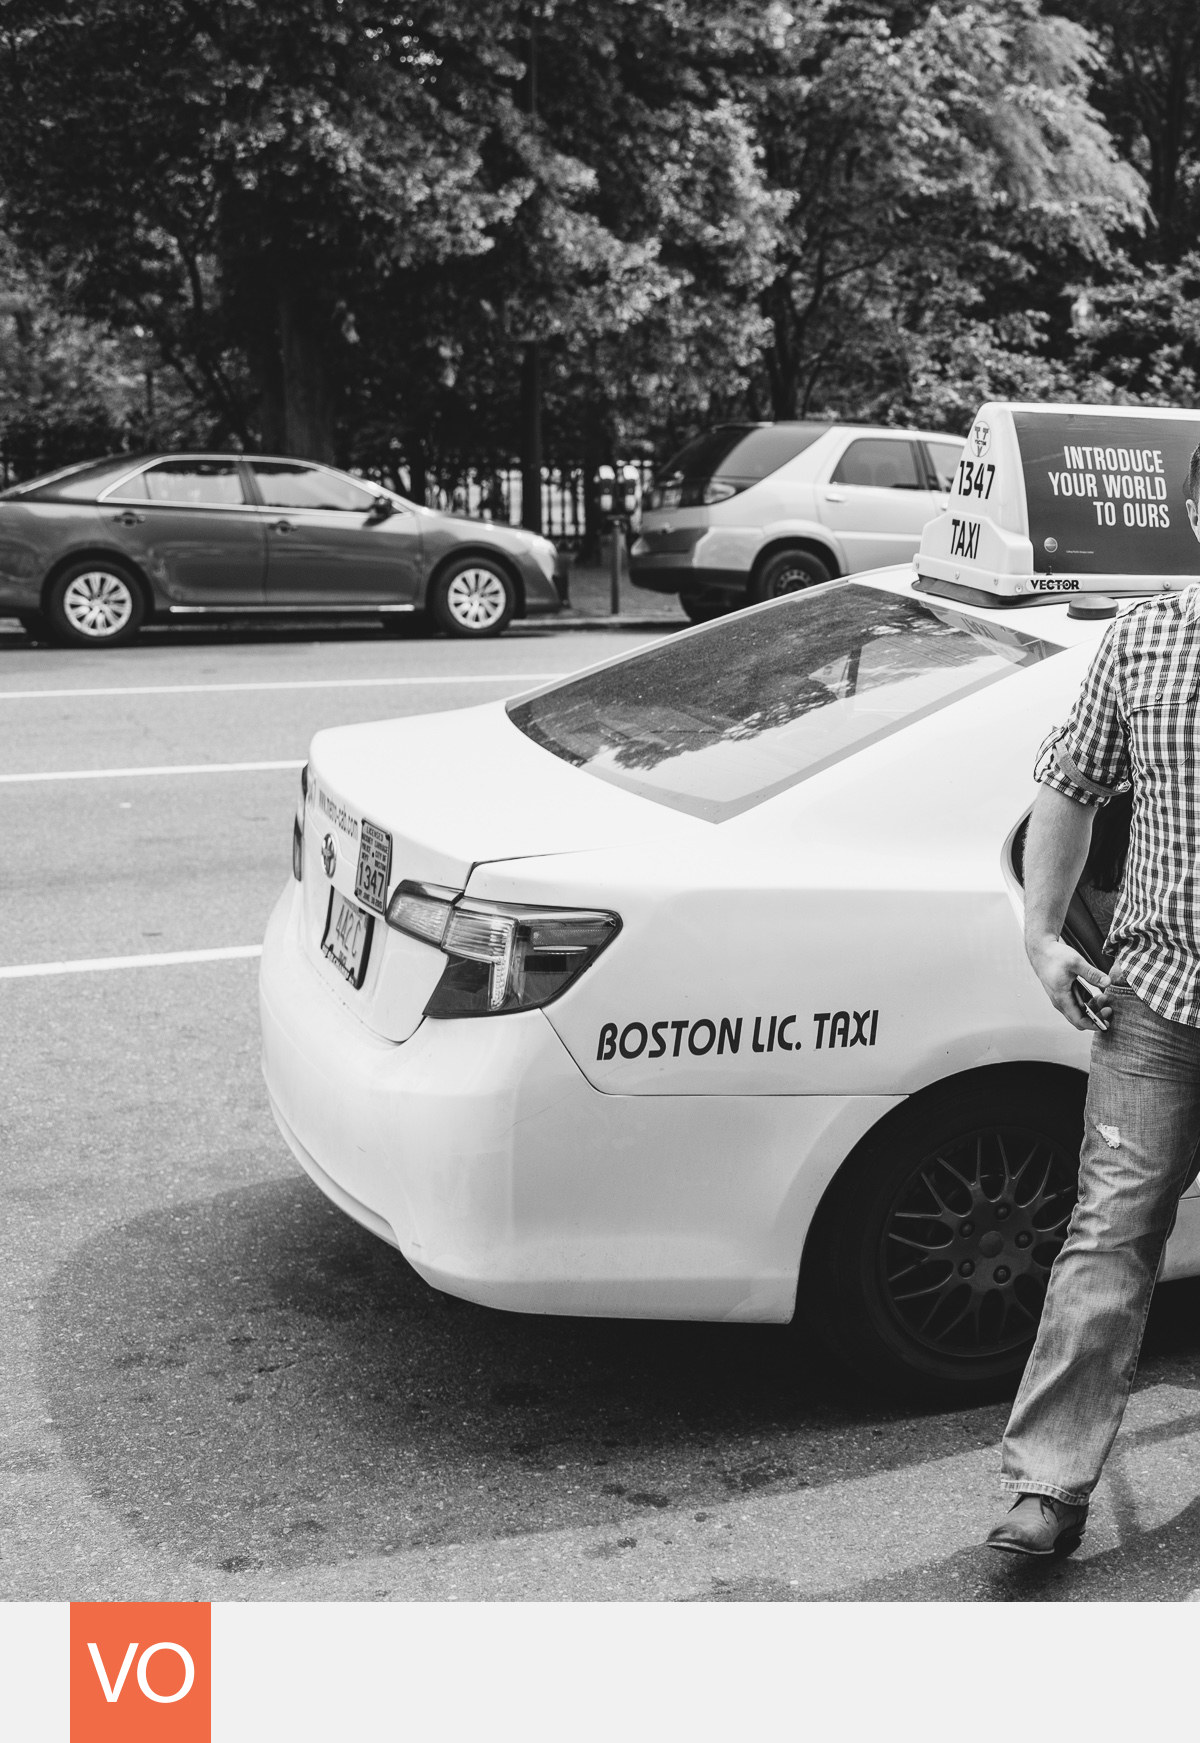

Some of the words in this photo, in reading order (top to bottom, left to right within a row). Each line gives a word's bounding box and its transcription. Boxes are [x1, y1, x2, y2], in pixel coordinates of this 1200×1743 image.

[1063, 445, 1165, 474] INTRODUCE
[958, 460, 996, 500] 1347
[1047, 471, 1098, 498] YOUR
[1101, 473, 1167, 501] WORLD
[1092, 501, 1117, 526] TO
[1122, 502, 1171, 529] OURS
[950, 518, 981, 560] TAXI
[1030, 579, 1080, 591] VECTOR
[359, 861, 385, 898] 1347
[596, 1017, 743, 1061] BOSTON
[752, 1014, 802, 1053] LIC.
[813, 1009, 879, 1050] TAXI
